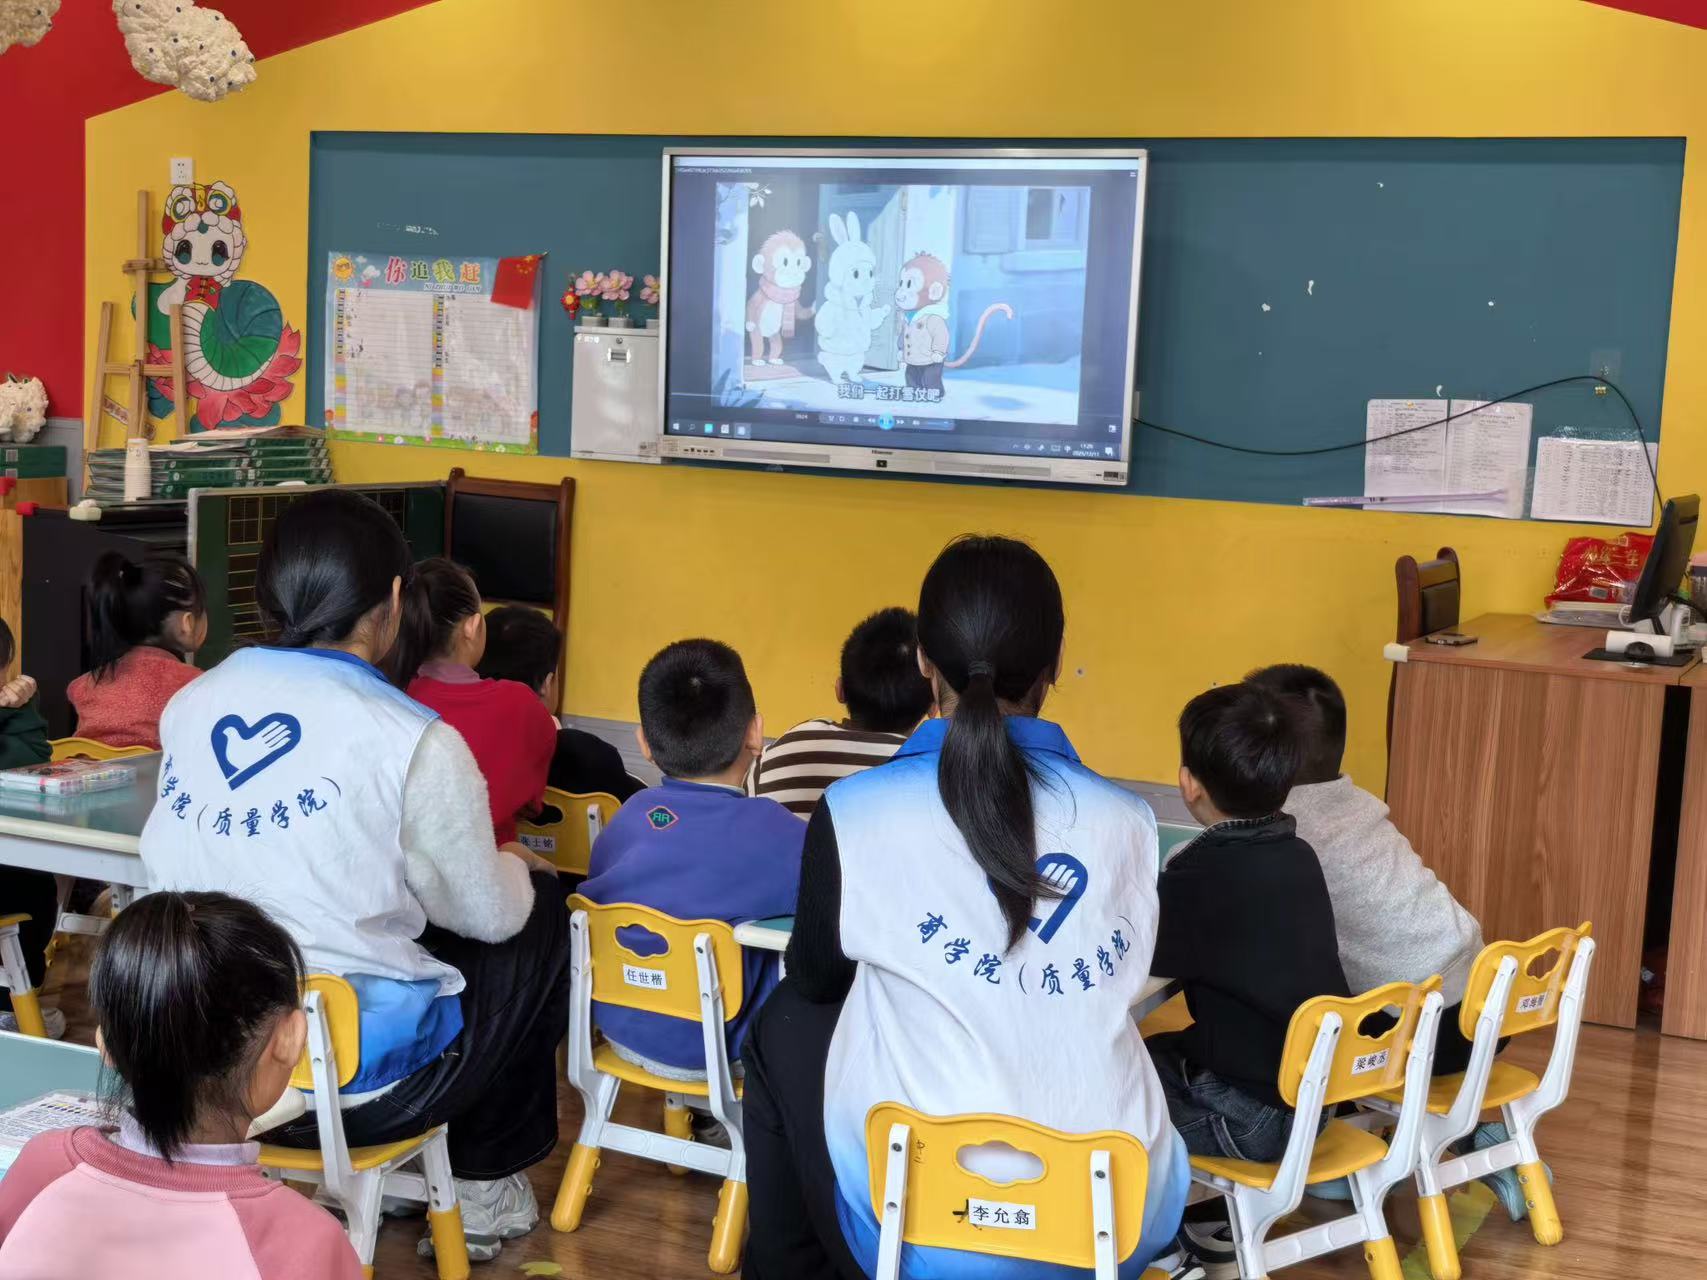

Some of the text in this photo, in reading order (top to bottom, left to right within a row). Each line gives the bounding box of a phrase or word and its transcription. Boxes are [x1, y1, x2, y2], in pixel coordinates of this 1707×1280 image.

[385, 256, 480, 284] 你追我赶
[838, 383, 941, 402] 我们一起打雪仗吧
